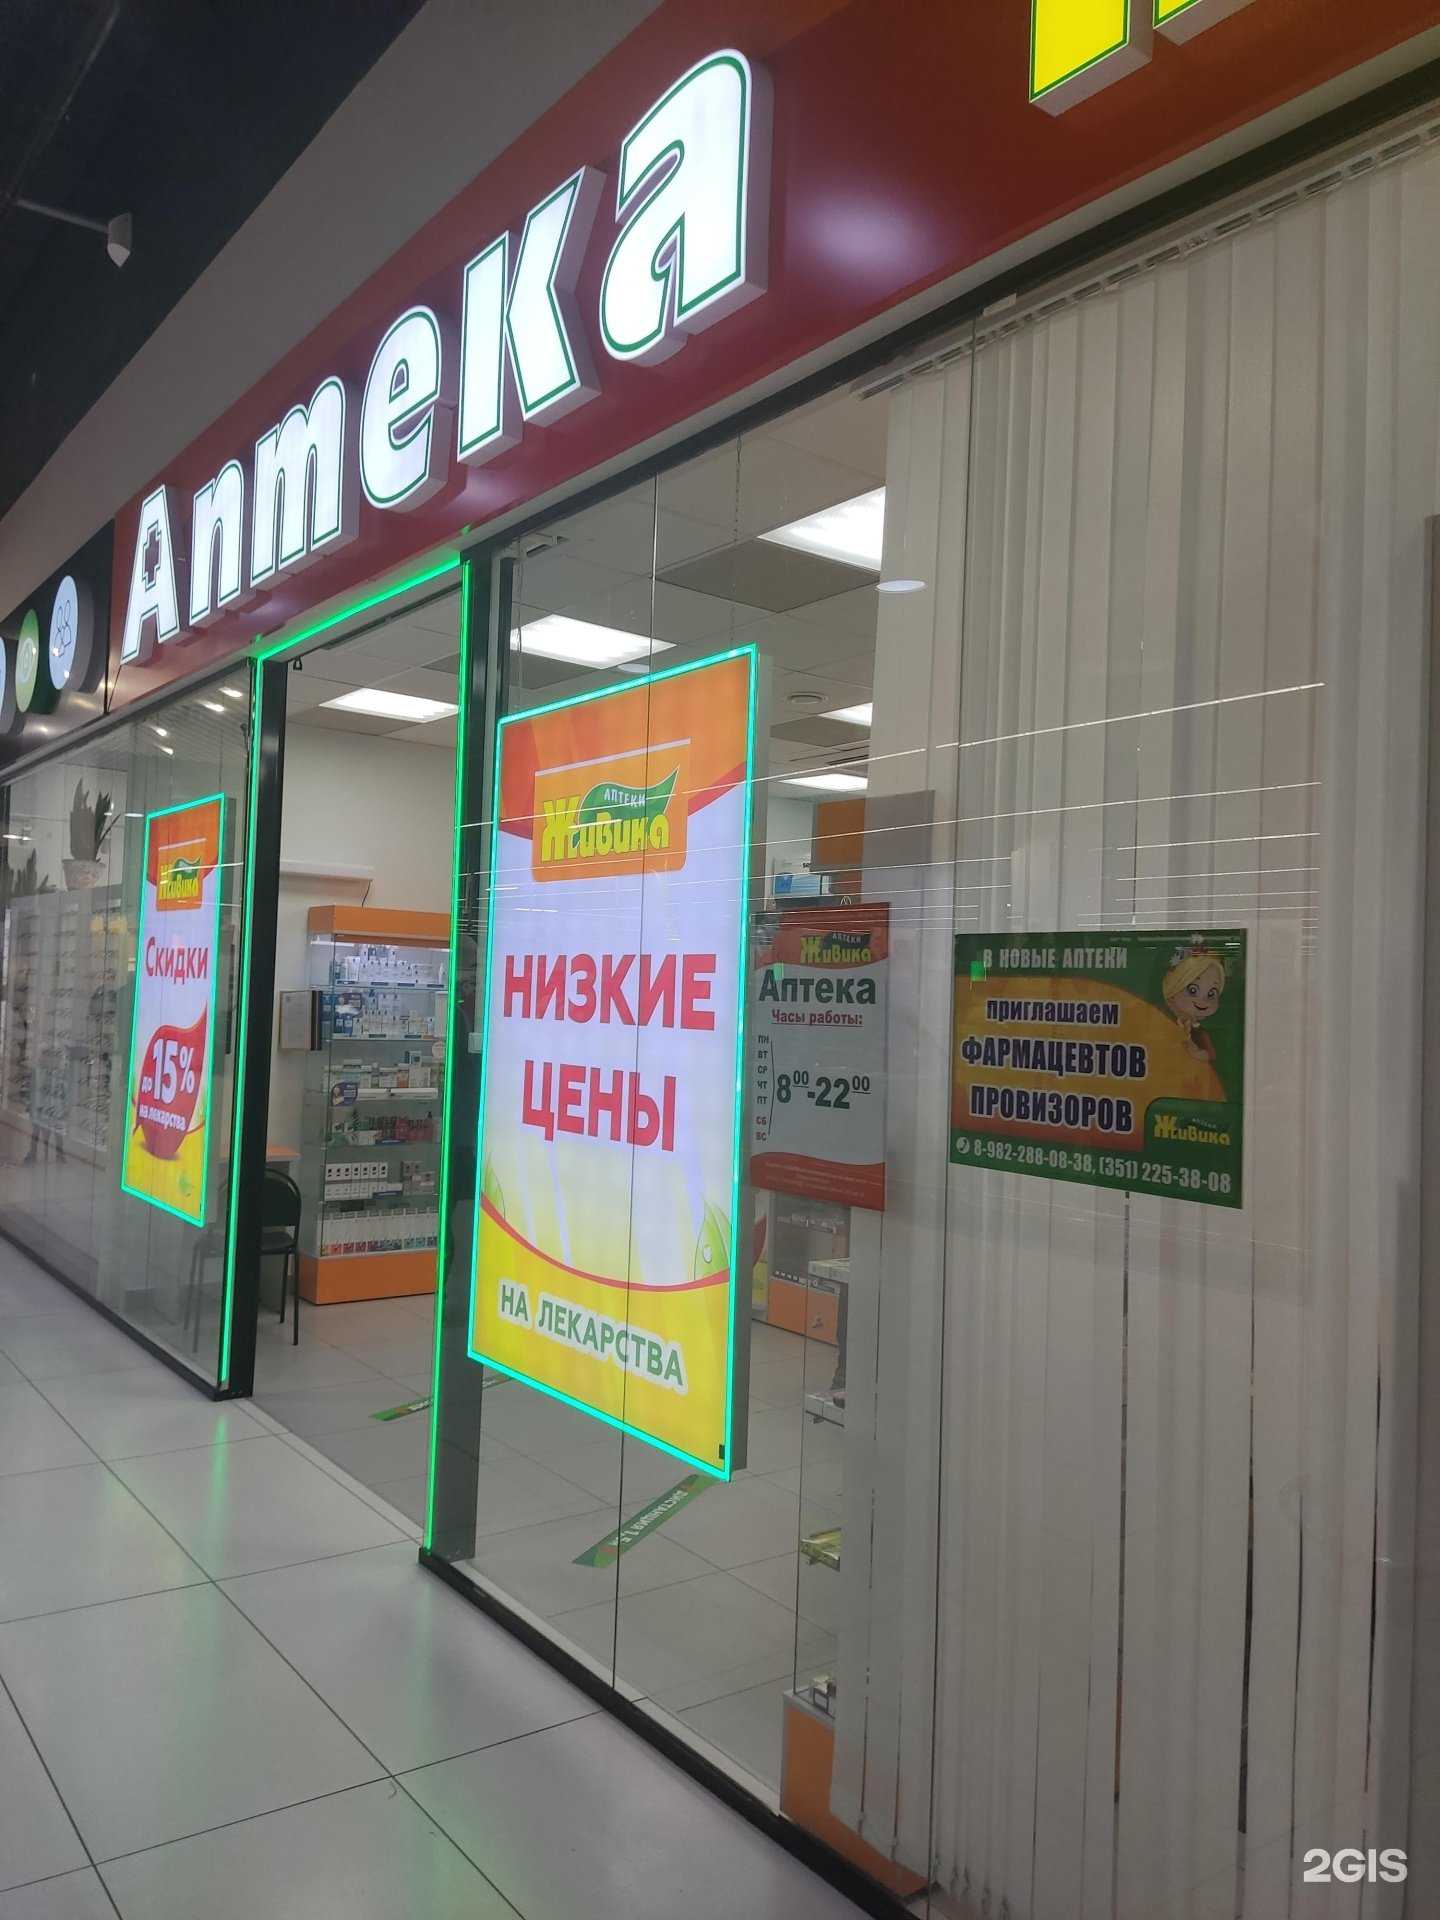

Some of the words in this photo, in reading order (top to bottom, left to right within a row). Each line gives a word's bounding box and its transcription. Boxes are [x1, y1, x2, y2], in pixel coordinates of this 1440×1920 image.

[120, 48, 752, 665] Аптека
[603, 787, 646, 808] АПТЕКИ
[541, 794, 669, 862] Живика
[145, 936, 208, 985] Скидки
[800, 935, 871, 964] Живика
[983, 949, 993, 968] В
[999, 947, 1056, 969] НОВЫЕ
[1062, 947, 1128, 970] АПТЕКИ
[503, 953, 717, 1032] НИЗКИЕ
[758, 968, 876, 1004] Аптека
[772, 1010, 806, 1023] Часы
[809, 1011, 863, 1026] работы:
[986, 999, 1119, 1026] приглашаем
[153, 1038, 196, 1105] 15%
[961, 1036, 1147, 1078] ФАРМАЦЕВТОВ
[522, 1059, 677, 1152] ЦЕНЫ
[971, 1085, 1132, 1132] ПРОВИЗОРОВ
[1154, 1114, 1231, 1146] Живика
[973, 1138, 1096, 1176] 8-982-288-08-38,
[1099, 1156, 1139, 1180] (351)
[1142, 1162, 1231, 1194] 225-38-08
[501, 1284, 529, 1322] НА
[538, 1299, 683, 1386] ЛЕКАРСТВА
